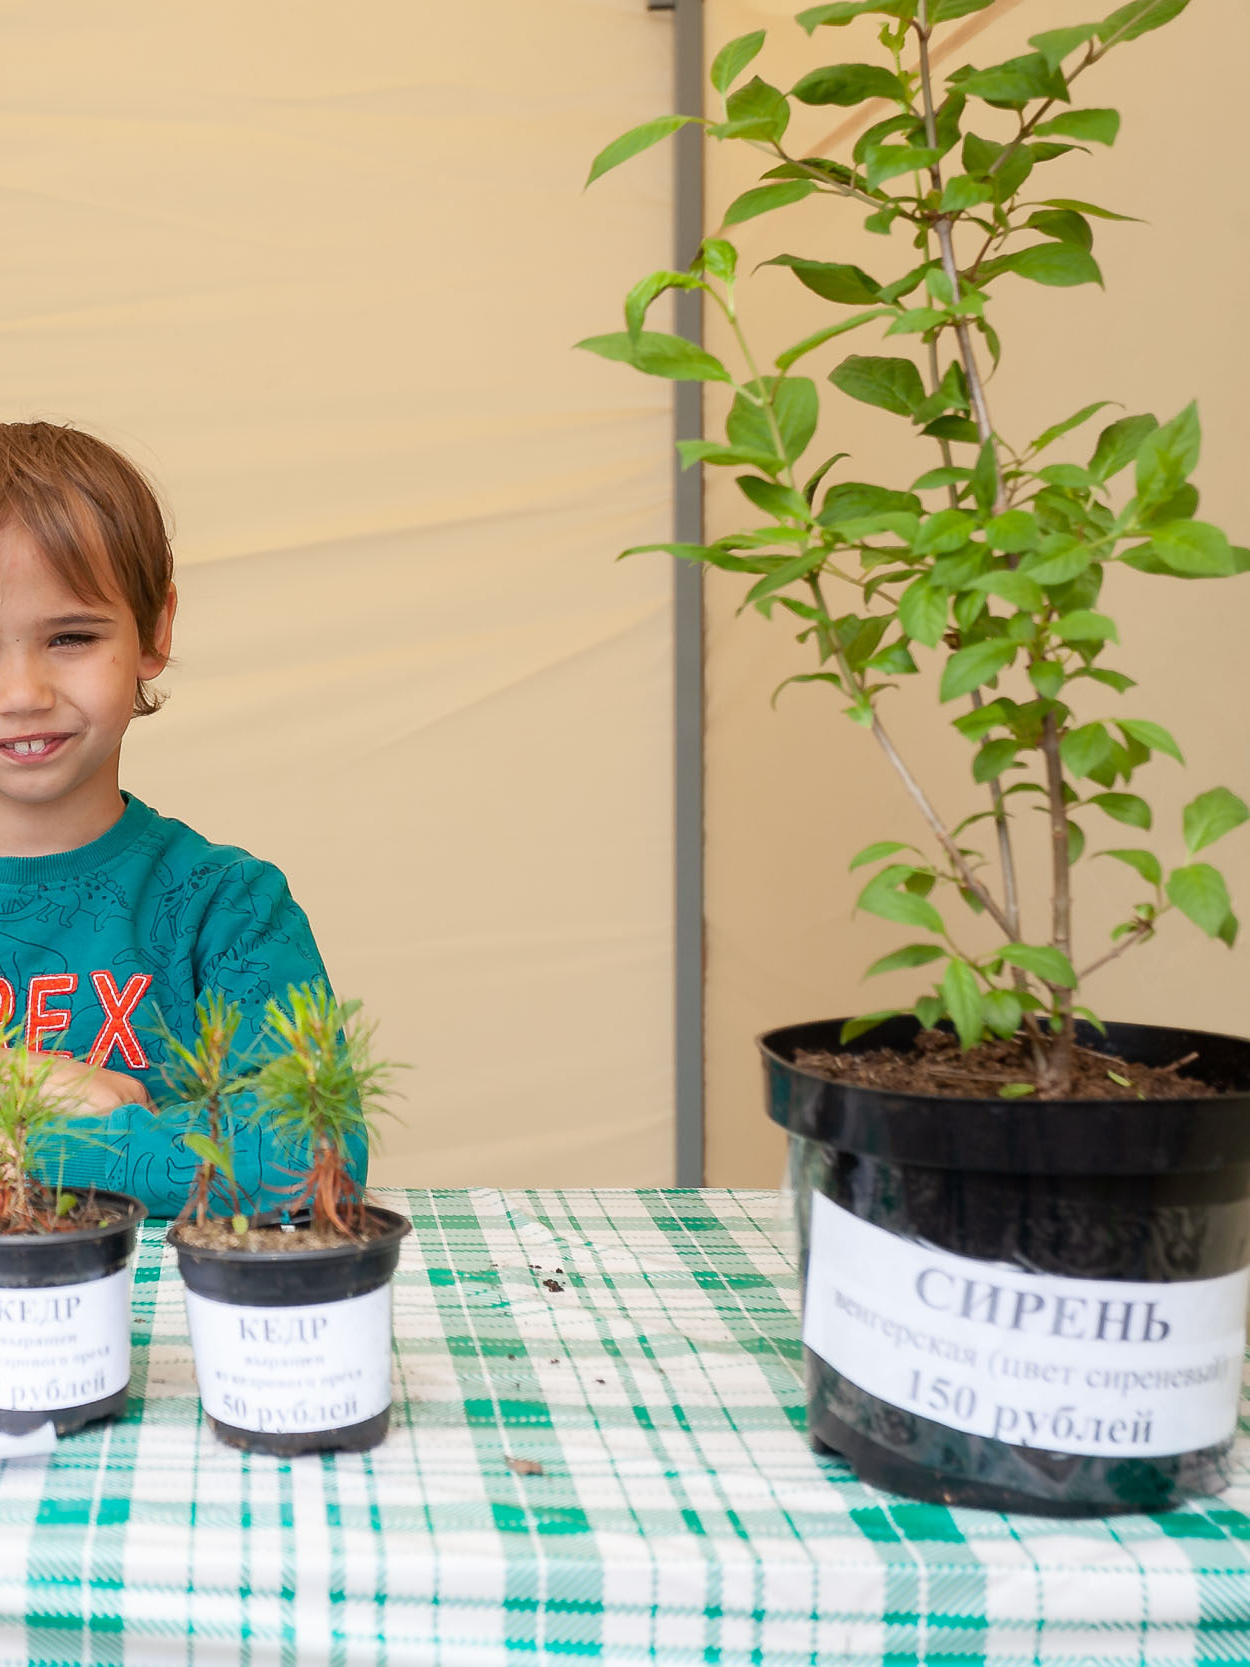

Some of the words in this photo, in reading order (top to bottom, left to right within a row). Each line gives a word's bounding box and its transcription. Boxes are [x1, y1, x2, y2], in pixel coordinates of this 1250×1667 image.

[238, 1316, 328, 1346] КЕДР
[914, 1266, 1172, 1344] СИРЕНЬ
[833, 1287, 978, 1369] венгерская
[987, 1348, 1073, 1387] (цвет
[10, 1368, 106, 1410] рублей
[222, 1394, 247, 1418] 50
[257, 1391, 358, 1433] рублей
[907, 1368, 977, 1421] 150
[993, 1402, 1155, 1446] рублей
